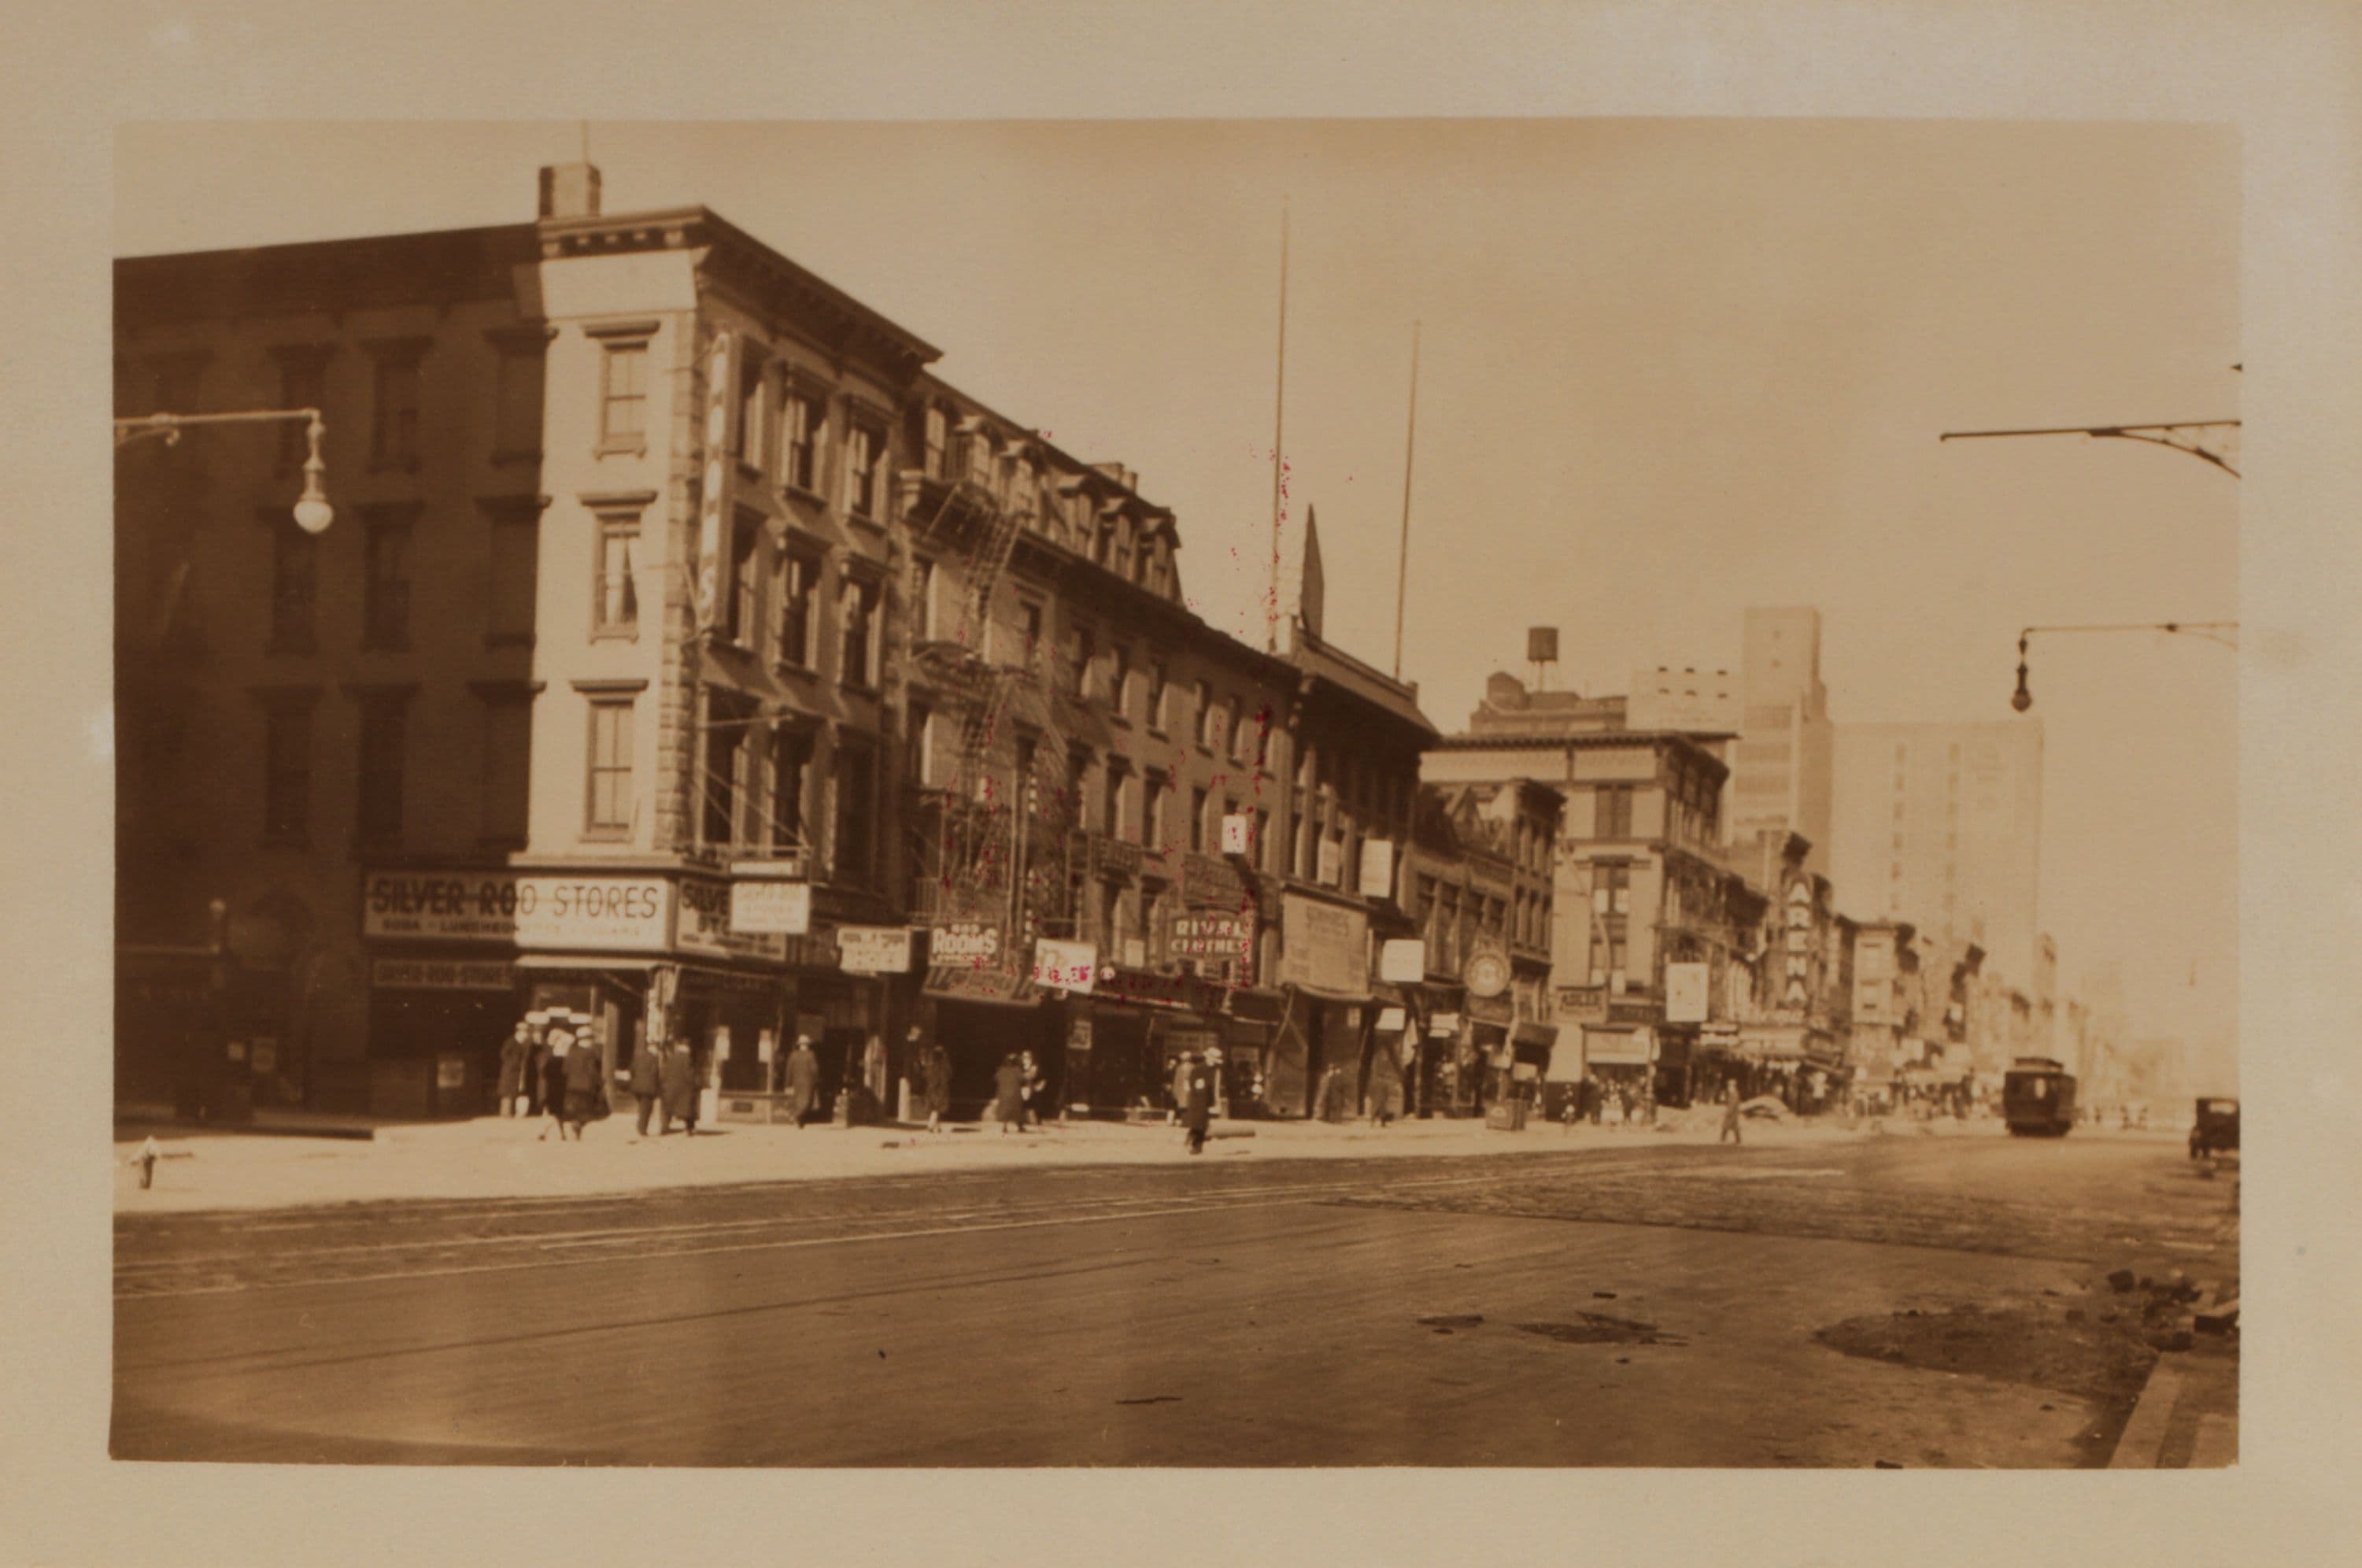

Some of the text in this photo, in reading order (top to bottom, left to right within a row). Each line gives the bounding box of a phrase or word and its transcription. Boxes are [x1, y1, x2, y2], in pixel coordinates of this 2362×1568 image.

[372, 879, 464, 916] SILVER
[553, 886, 658, 919] STORES
[932, 926, 999, 955] ROOMS
[1176, 919, 1247, 938] RIVAL
[1785, 881, 1812, 1003] ARENA
